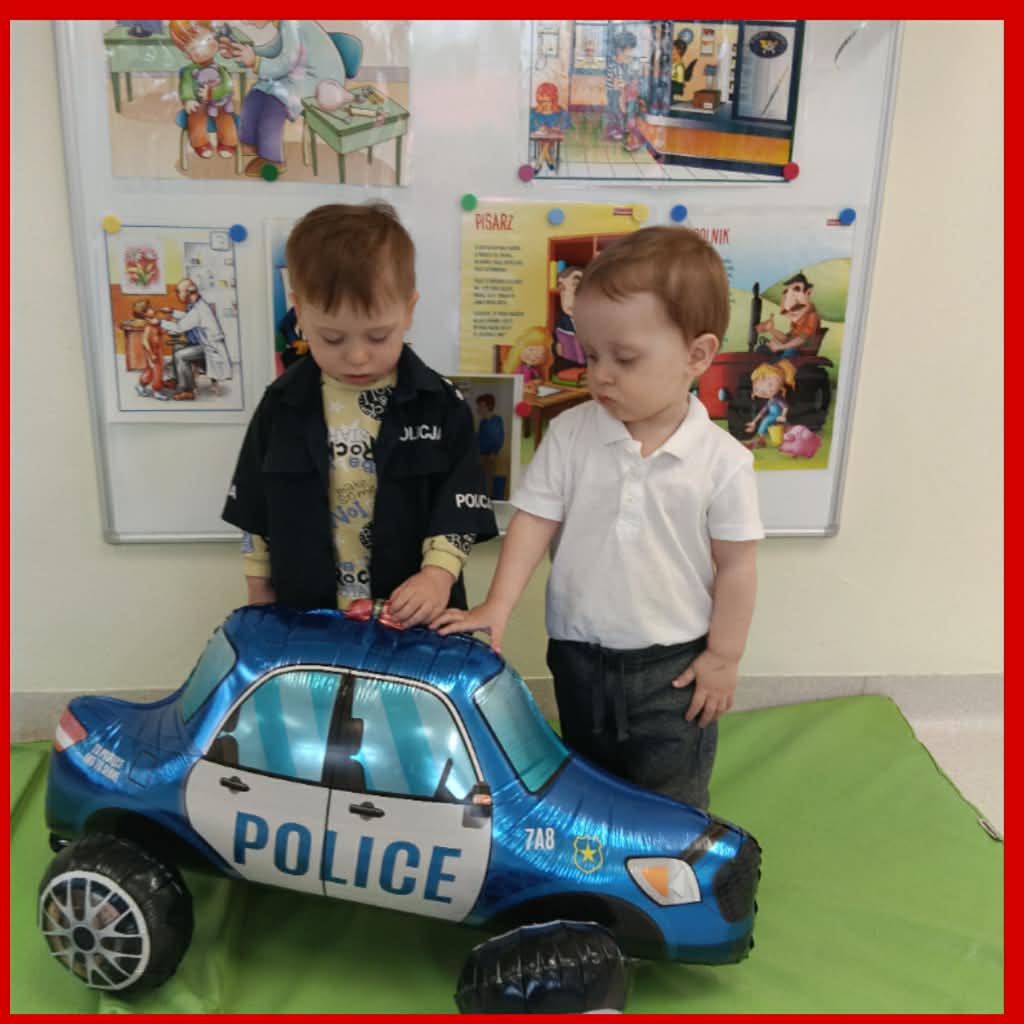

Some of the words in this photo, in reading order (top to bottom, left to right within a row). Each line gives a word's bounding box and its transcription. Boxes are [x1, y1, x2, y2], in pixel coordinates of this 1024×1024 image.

[475, 212, 514, 231] PISARZ
[525, 827, 555, 850] 7A8
[233, 810, 462, 904] POLICE
